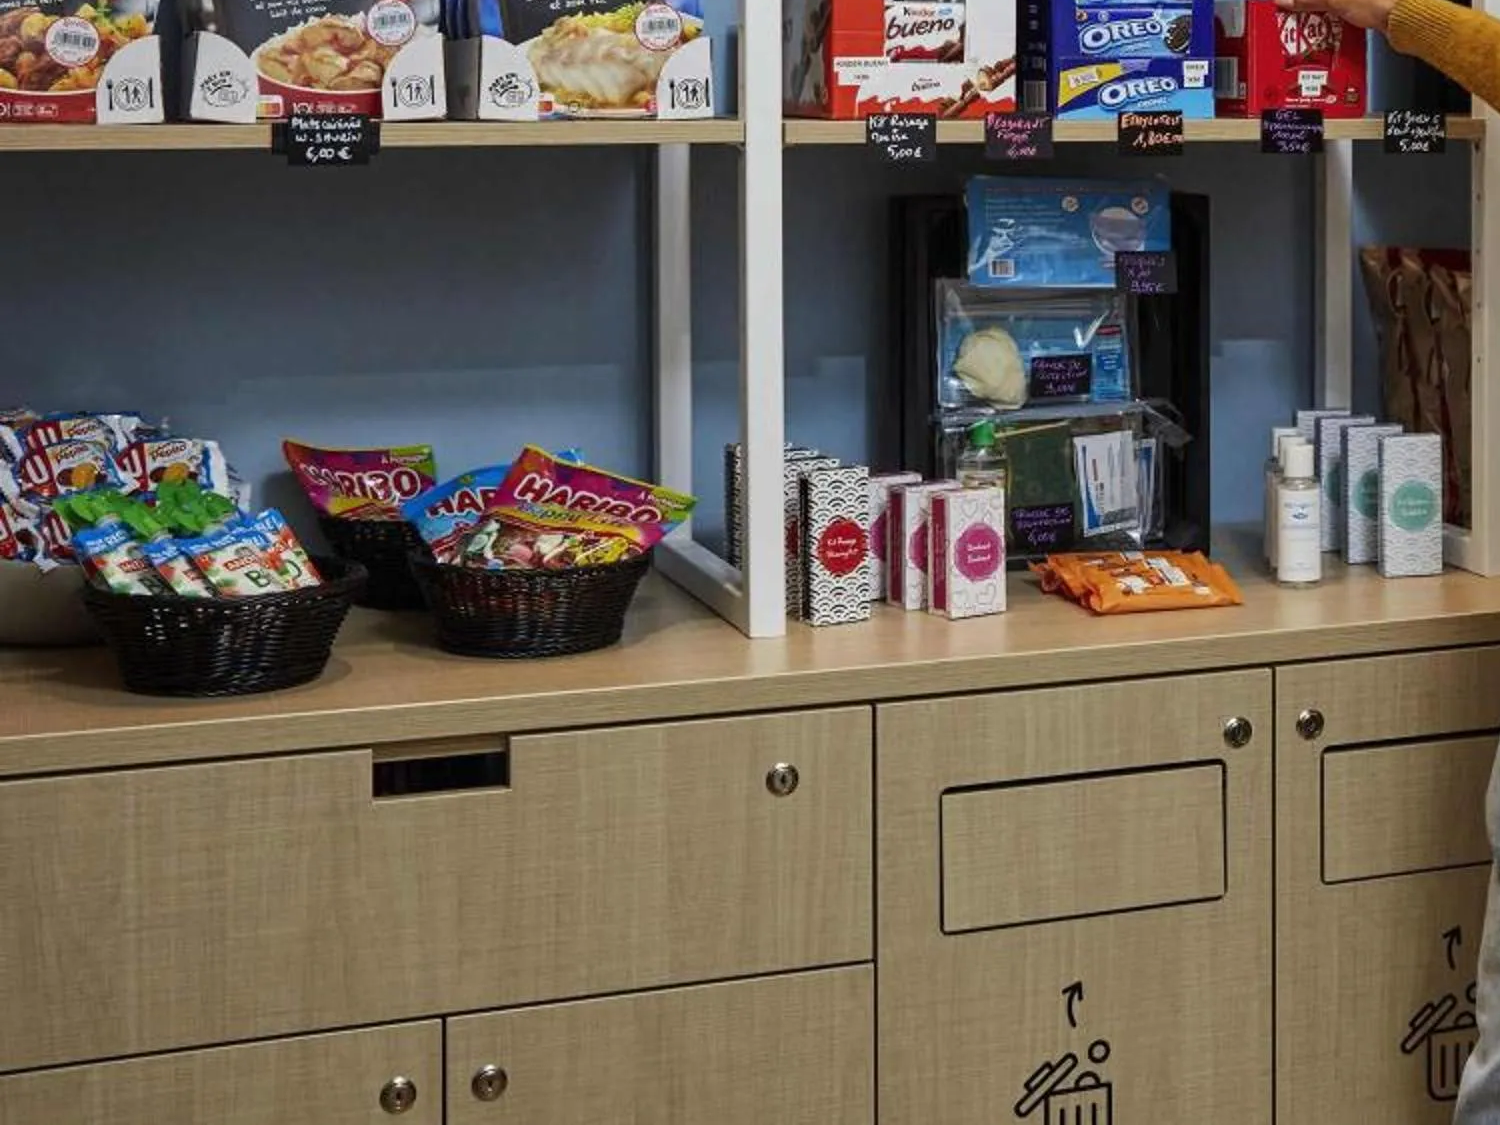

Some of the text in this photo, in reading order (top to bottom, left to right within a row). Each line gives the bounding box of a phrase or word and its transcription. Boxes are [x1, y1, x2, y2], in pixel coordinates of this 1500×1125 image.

[886, 16, 955, 40] bueno
[1080, 18, 1163, 50] OREO
[1101, 77, 1176, 106] OREO
[513, 472, 662, 524] HARIBO
